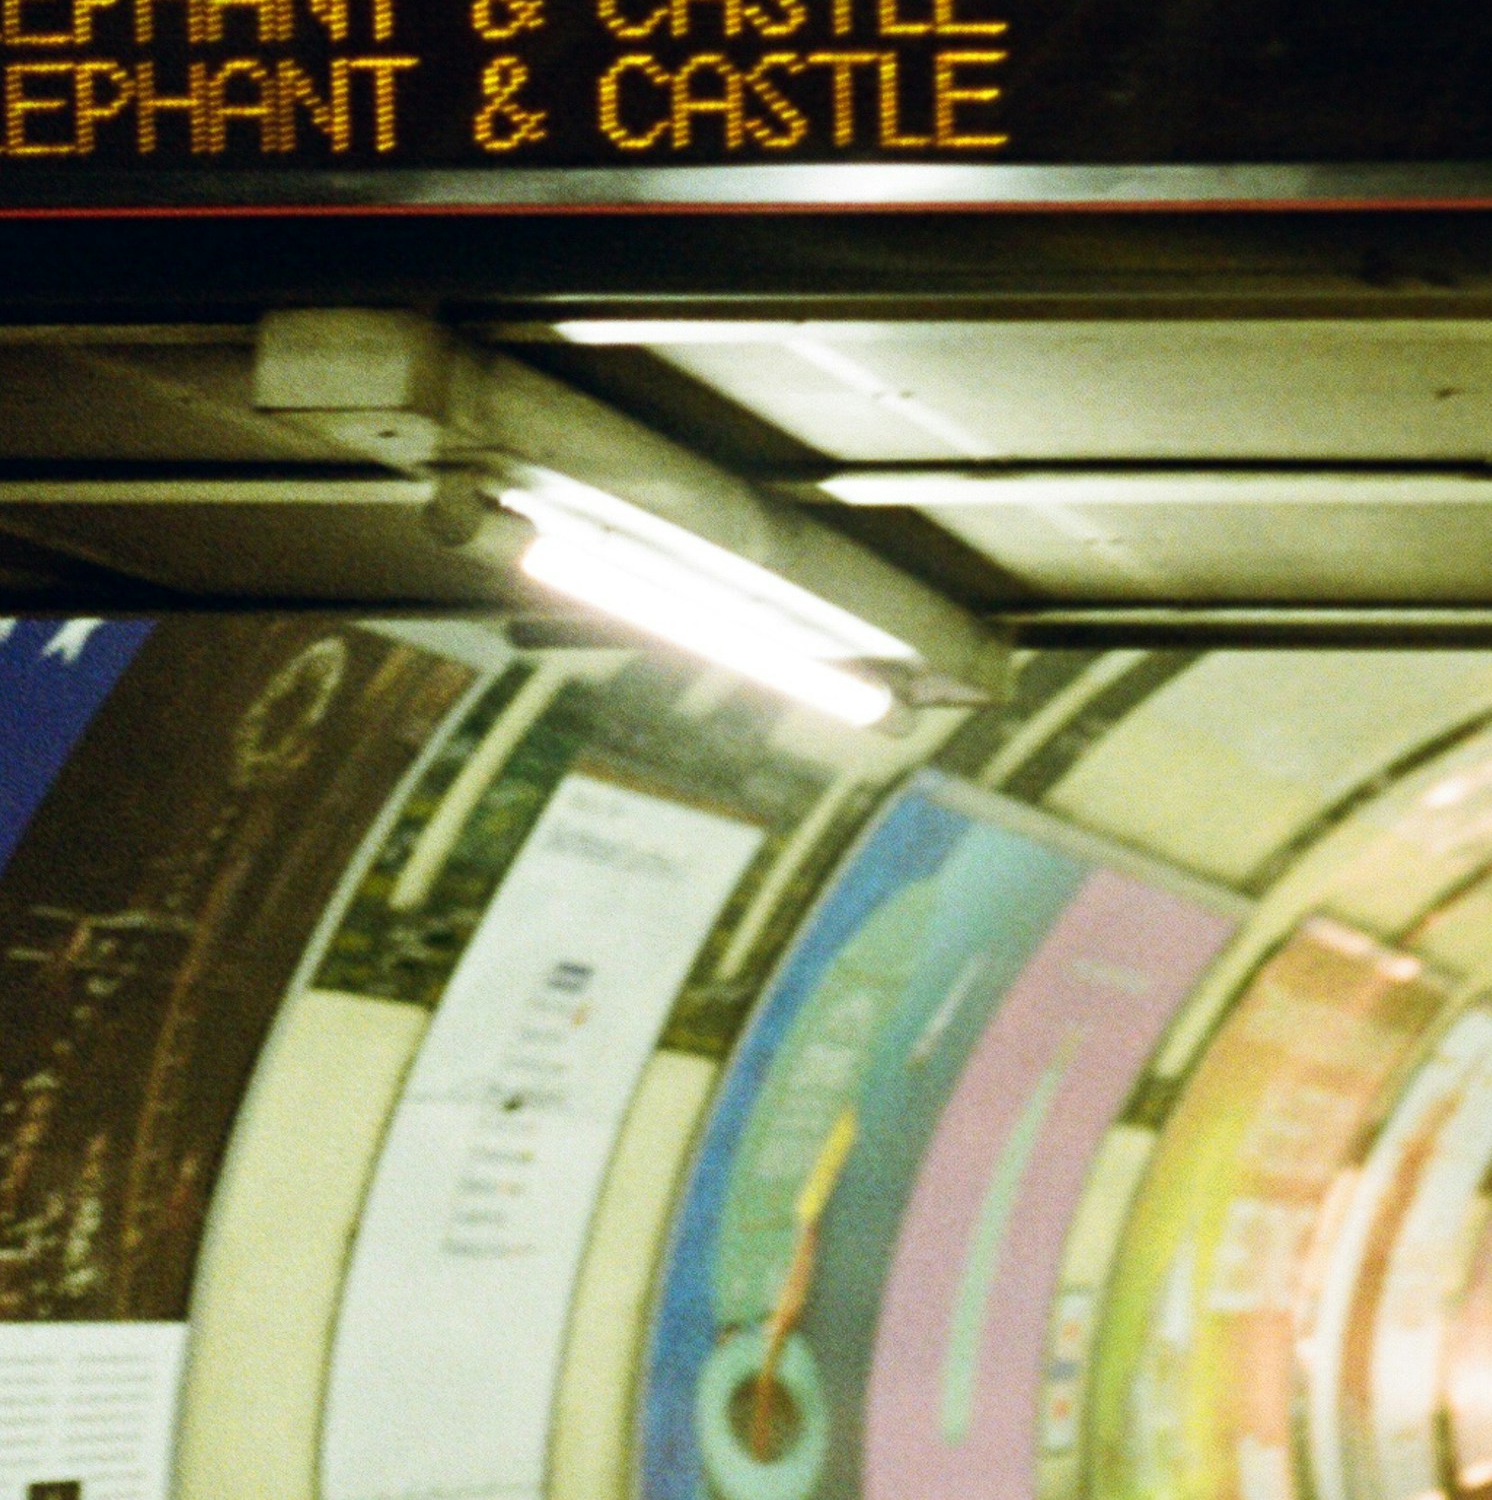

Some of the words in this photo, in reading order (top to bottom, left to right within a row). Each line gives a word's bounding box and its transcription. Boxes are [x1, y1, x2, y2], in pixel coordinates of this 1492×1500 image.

[0, 55, 419, 156] EPHANT
[474, 55, 545, 152] &
[598, 50, 1008, 150] CASTLE
